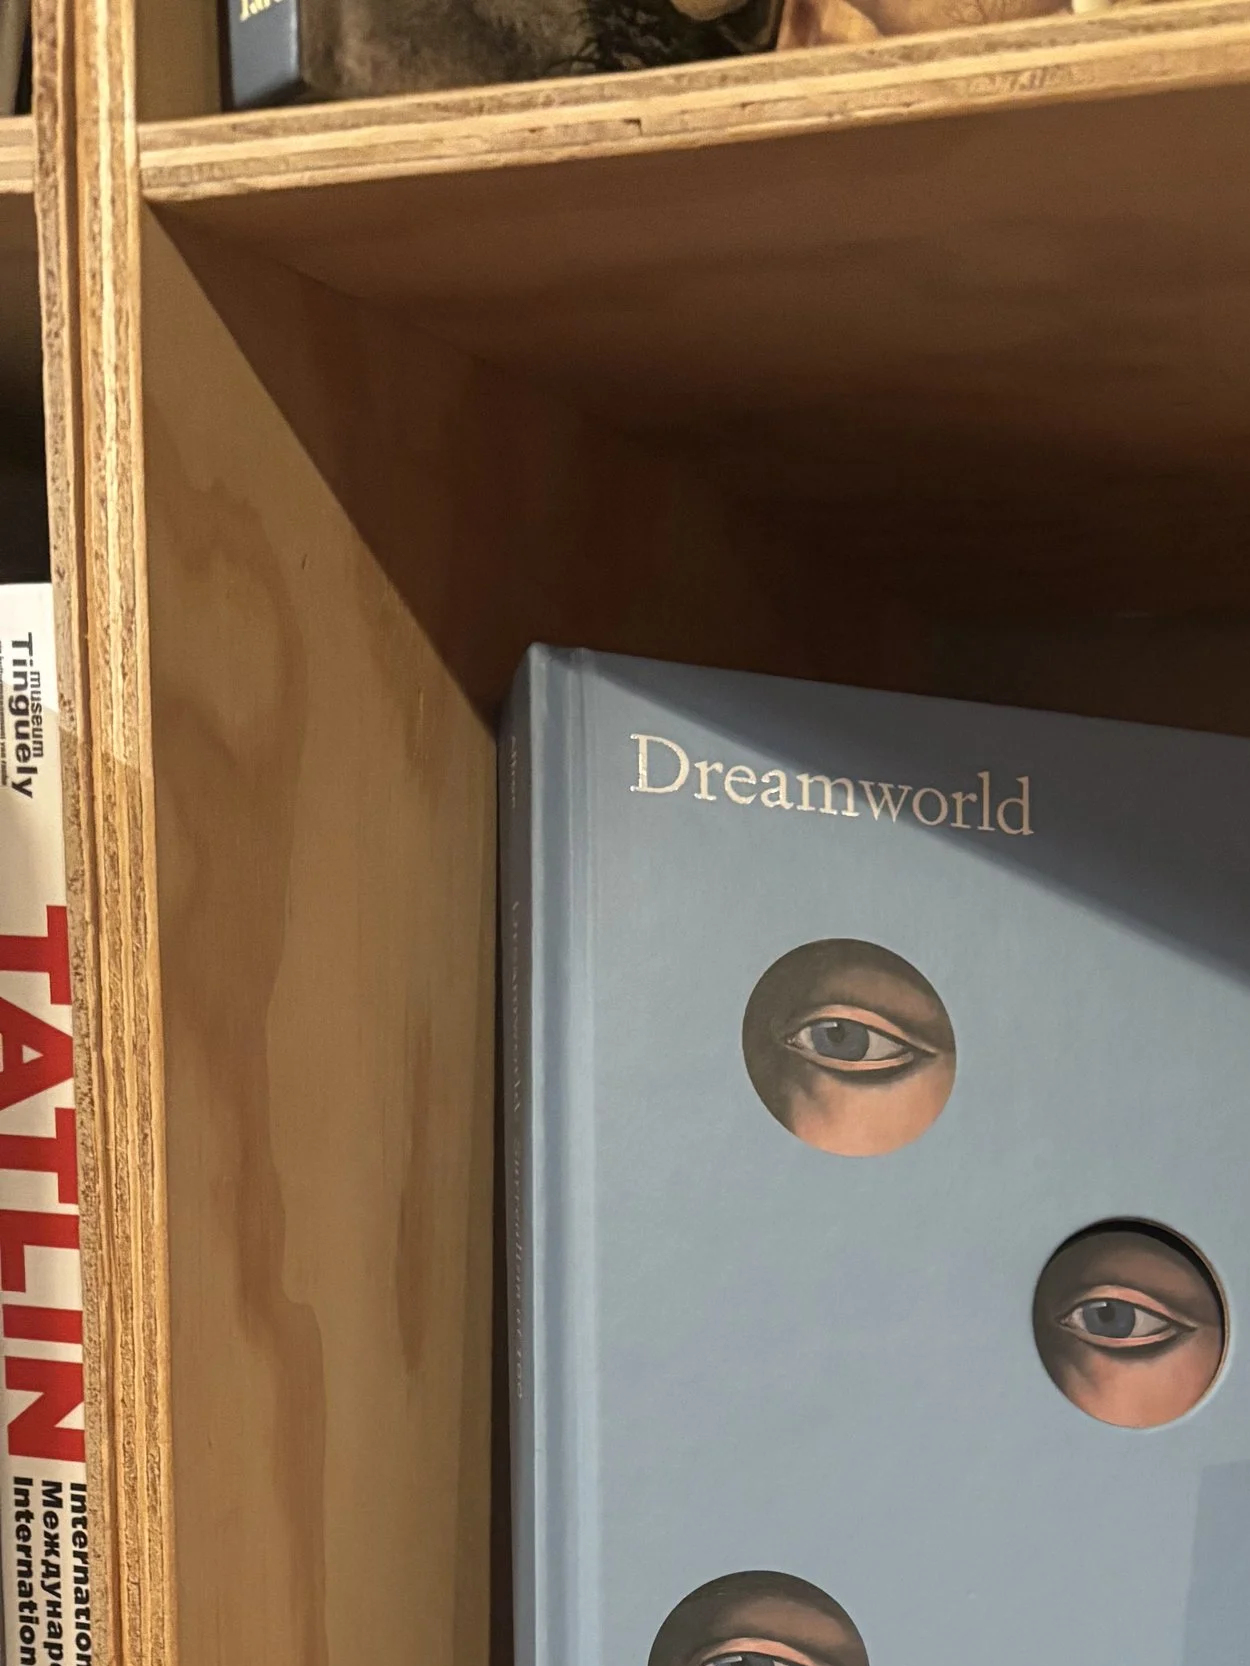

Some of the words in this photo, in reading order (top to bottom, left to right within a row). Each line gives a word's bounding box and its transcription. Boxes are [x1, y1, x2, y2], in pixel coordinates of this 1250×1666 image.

[8, 632, 38, 799] Tinguely
[29, 670, 44, 758] museum
[630, 733, 1035, 835] Dreamworld
[0, 904, 86, 1463] TATLIN
